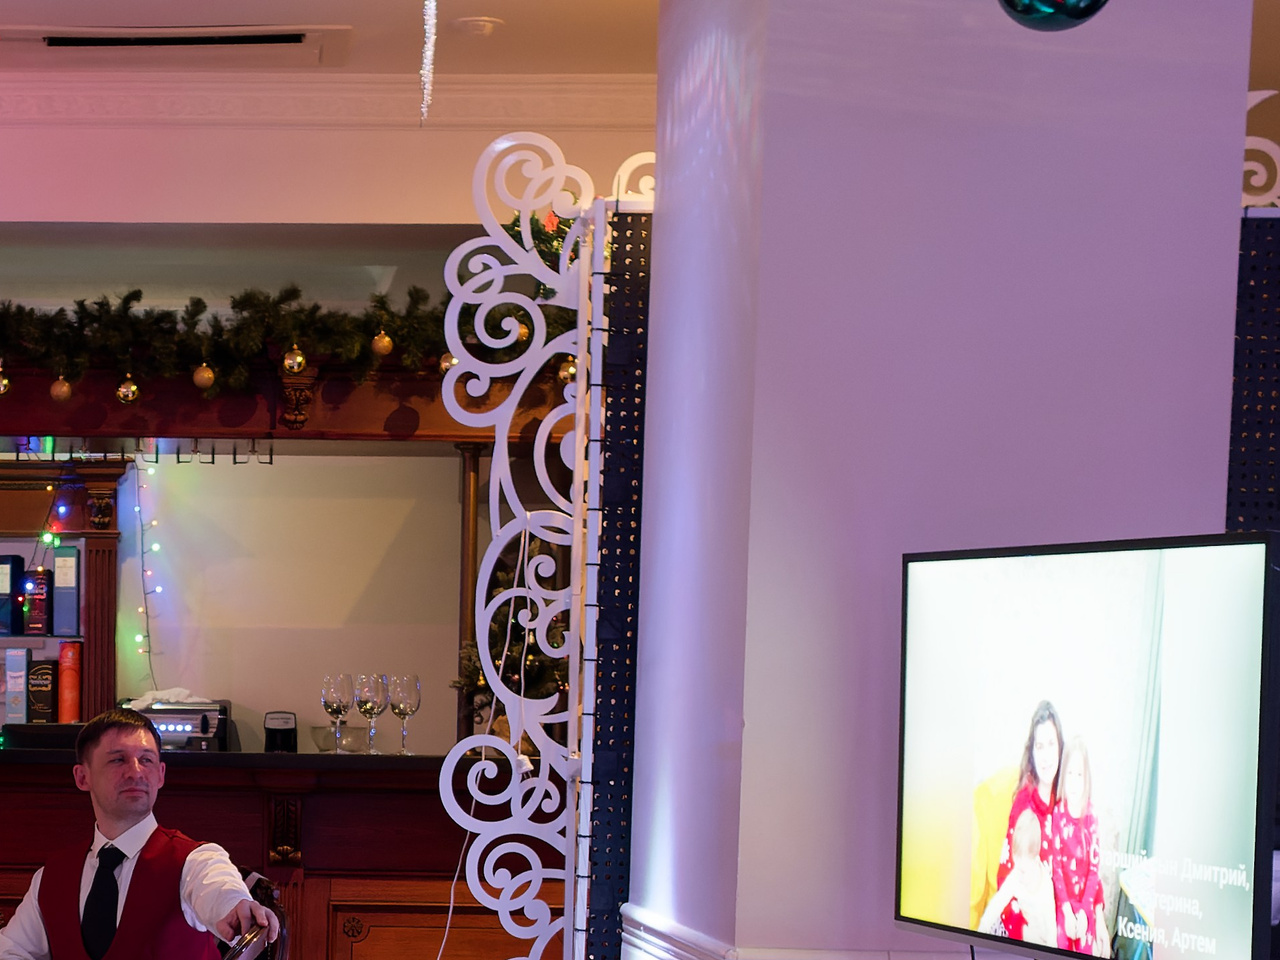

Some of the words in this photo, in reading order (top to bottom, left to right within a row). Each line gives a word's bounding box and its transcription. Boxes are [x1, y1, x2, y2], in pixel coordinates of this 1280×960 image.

[1180, 857, 1250, 891] Дмитрий,
[1118, 915, 1169, 949] Ксения,
[1171, 926, 1217, 955] Артем
